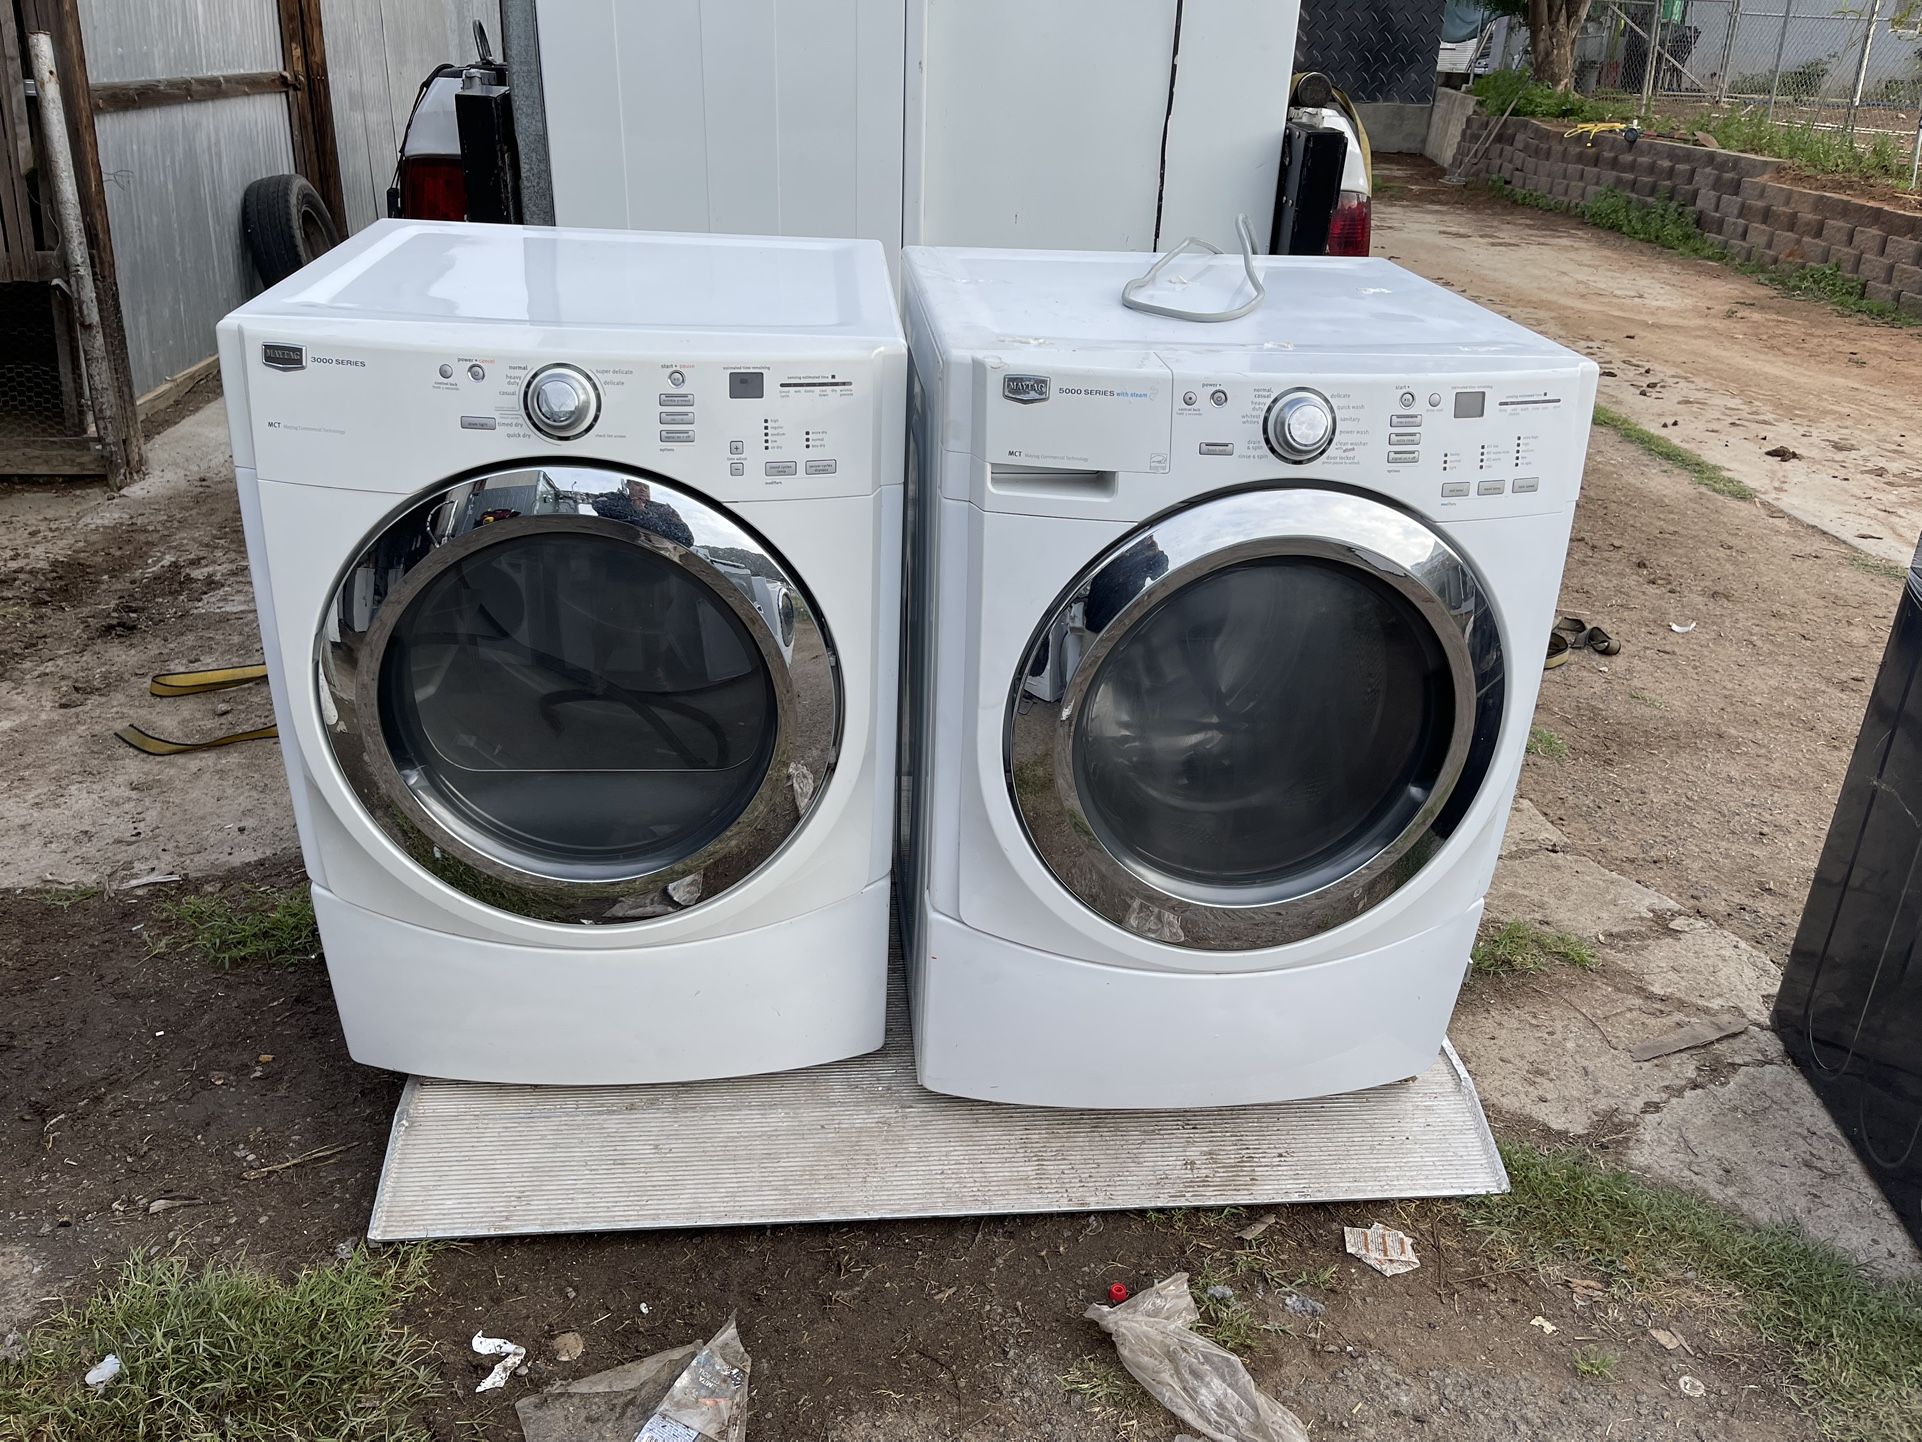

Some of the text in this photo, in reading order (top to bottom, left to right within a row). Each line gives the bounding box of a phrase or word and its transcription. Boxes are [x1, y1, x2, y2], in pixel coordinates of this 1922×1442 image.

[266, 349, 301, 360] MAYTAG
[310, 356, 366, 368] 3000 SERIES
[1009, 381, 1045, 393] MAYTAG
[1084, 388, 1115, 397] SERIES
